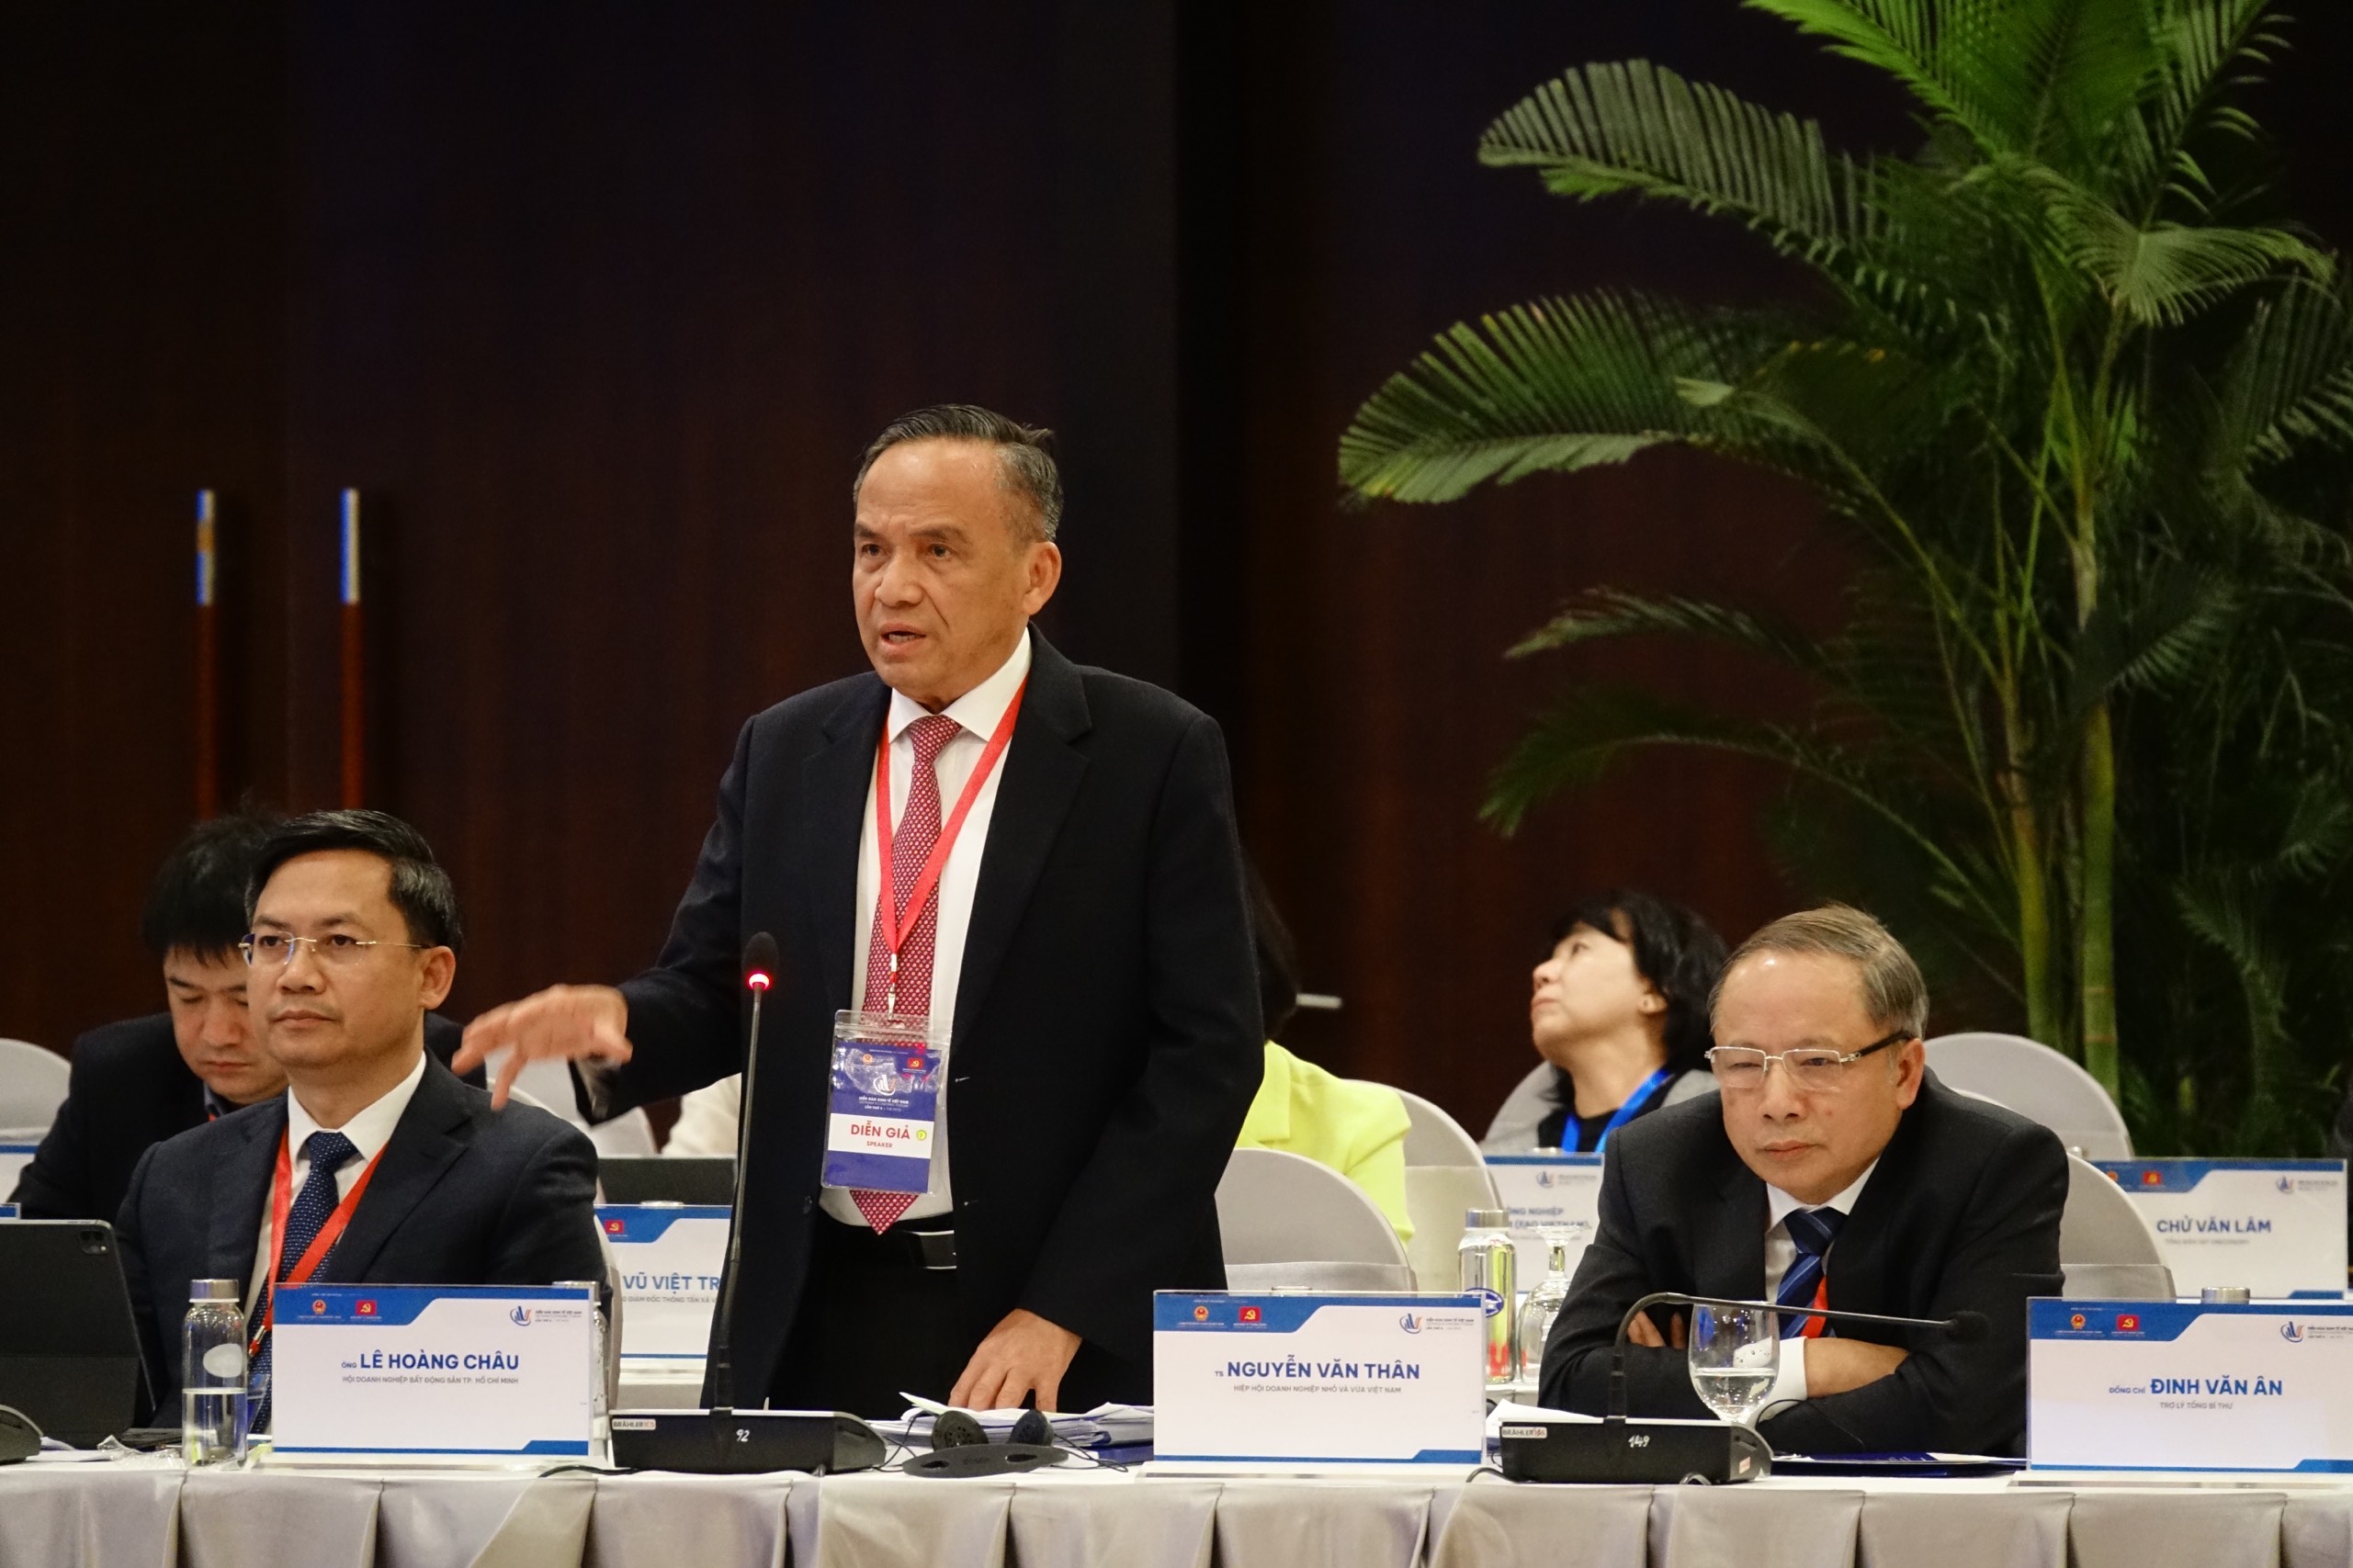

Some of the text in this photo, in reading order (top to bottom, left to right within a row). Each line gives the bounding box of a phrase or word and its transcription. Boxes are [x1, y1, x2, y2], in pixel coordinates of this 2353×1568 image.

[851, 1120, 911, 1139] DIỄN GIẢ
[1507, 1206, 1526, 1215] ÔNG
[2196, 1215, 2231, 1233] VĂN
[2234, 1215, 2271, 1233] LÂM
[623, 1271, 720, 1294] VŨ VIỆT TR
[360, 1349, 383, 1369] LÊ
[389, 1349, 458, 1370] HOÀNG
[463, 1350, 519, 1371] CHÂU
[1227, 1354, 1311, 1378] NGUYỄN
[1317, 1359, 1359, 1379] VĂN
[1363, 1359, 1420, 1380] THÂN
[356, 1376, 381, 1384] DOANH
[382, 1376, 408, 1384] NGHIỆP
[487, 1376, 500, 1384] CHÍ
[501, 1376, 518, 1384] MINH
[1293, 1385, 1320, 1393] NGHIỆP
[2150, 1379, 2200, 1394] ĐINH
[2205, 1374, 2248, 1395] VĂN
[2253, 1375, 2283, 1395] ÂN
[736, 1428, 750, 1442] 92
[1628, 1434, 1650, 1448] 149
